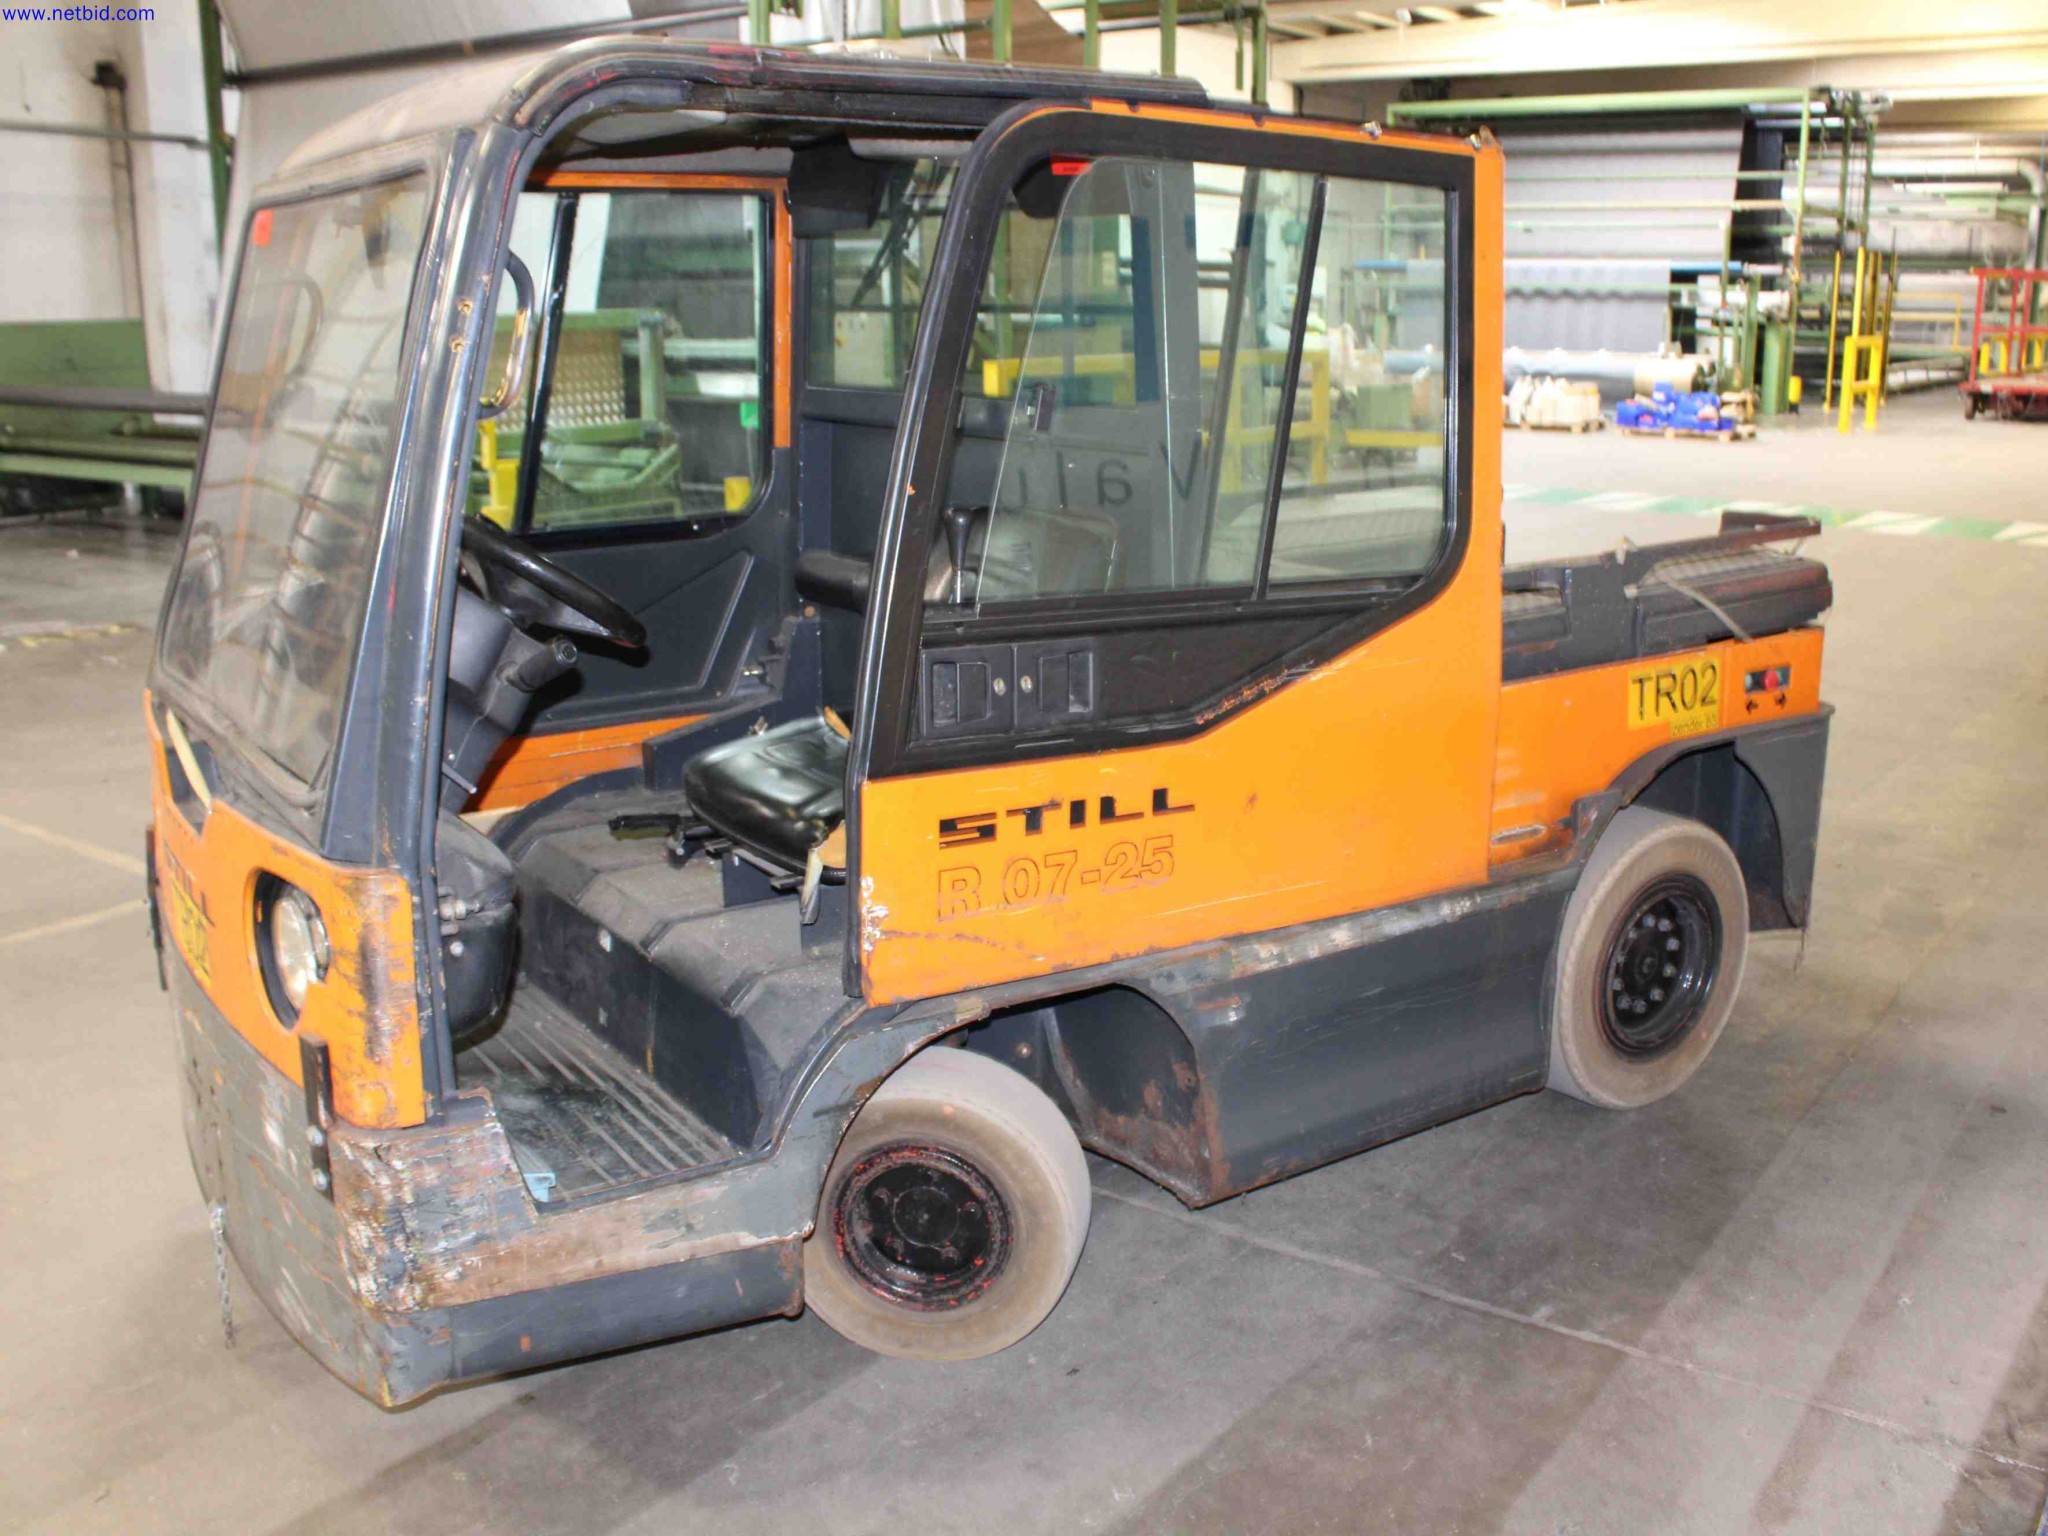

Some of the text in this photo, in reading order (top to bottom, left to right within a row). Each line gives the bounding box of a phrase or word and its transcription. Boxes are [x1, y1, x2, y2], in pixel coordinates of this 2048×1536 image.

[1631, 662, 1718, 720] TR02
[938, 786, 1196, 850] STILL
[938, 834, 1176, 922] R 07-25
